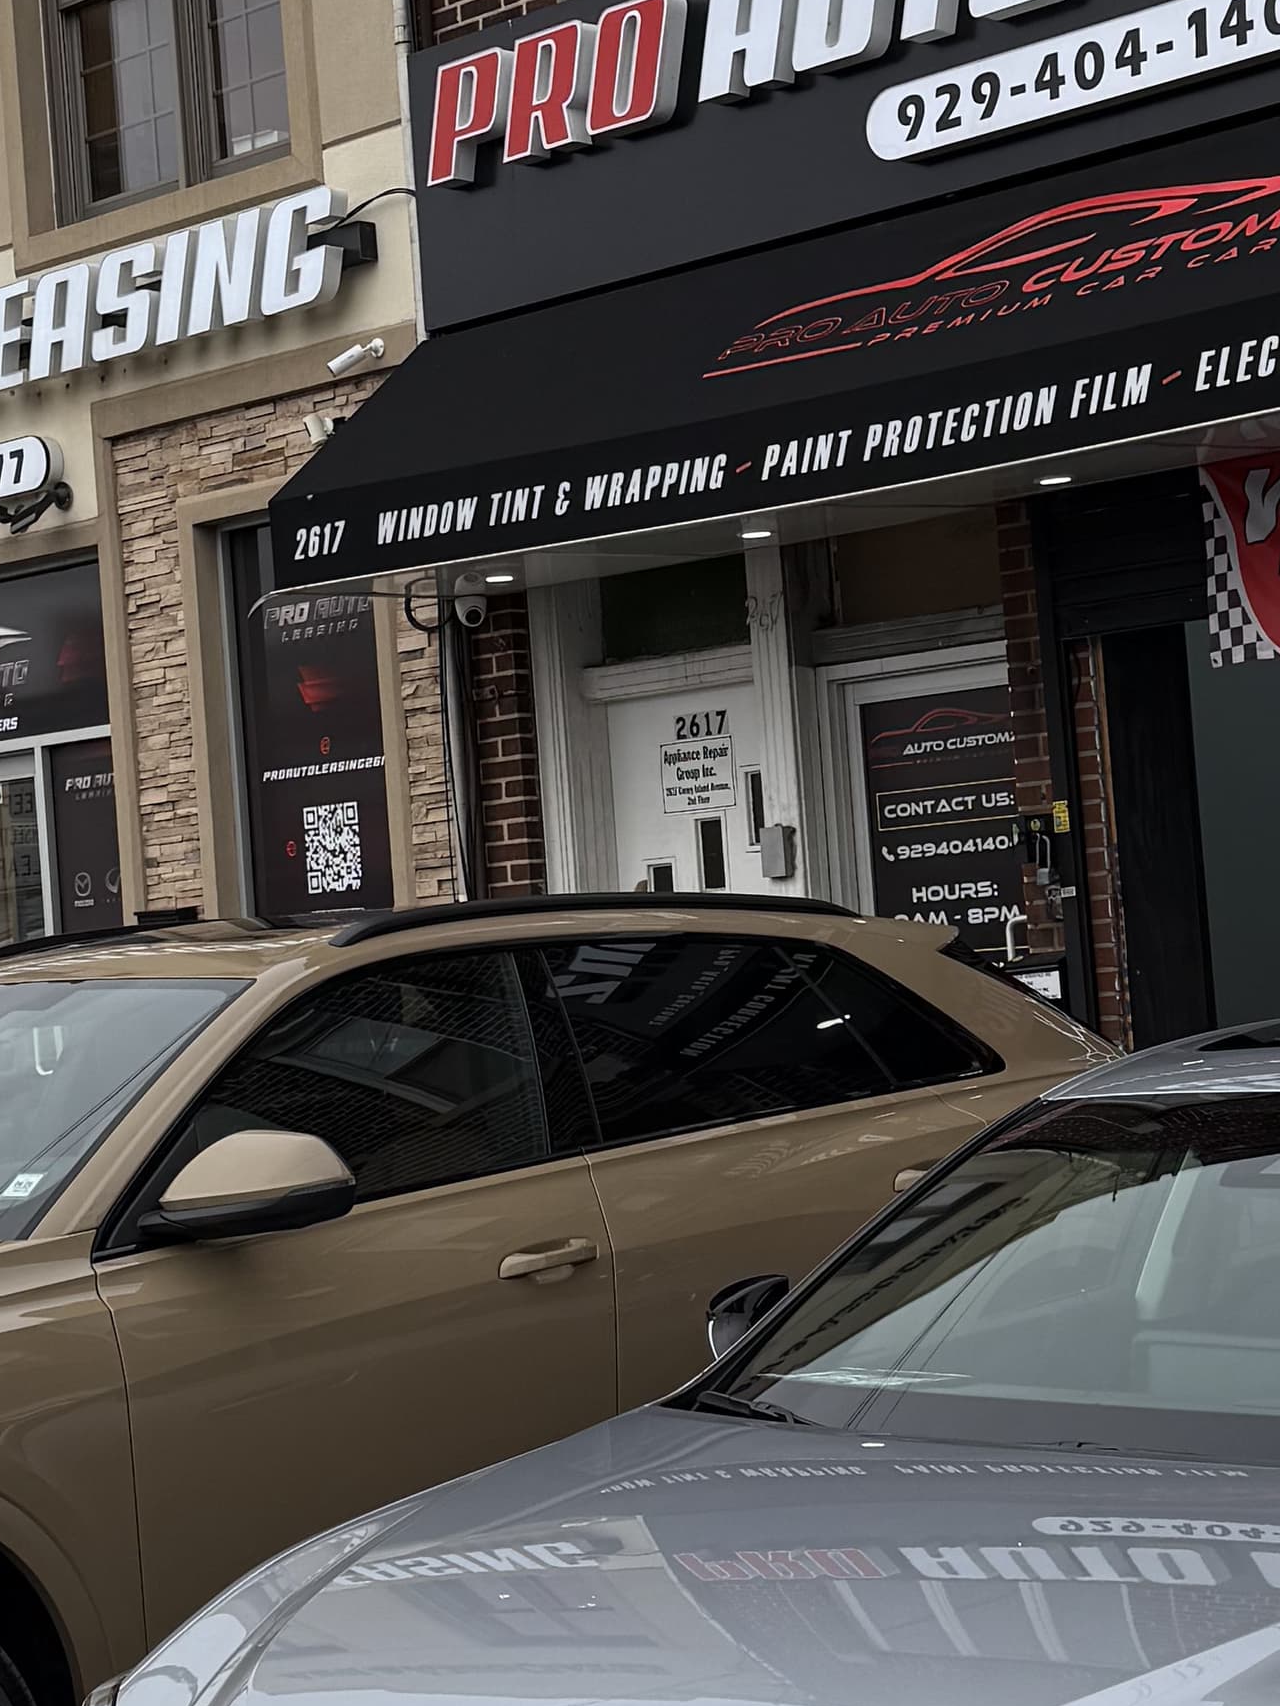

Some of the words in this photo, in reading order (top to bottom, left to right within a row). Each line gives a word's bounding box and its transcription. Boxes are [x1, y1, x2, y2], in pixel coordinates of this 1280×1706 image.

[718, 316, 842, 361] PRO
[842, 279, 1011, 335] AUTO
[868, 294, 1053, 348] PREMIUM
[1076, 266, 1162, 297] CAR
[293, 519, 347, 561] 2617
[377, 496, 478, 546] WINDOW
[488, 484, 546, 527] TINT
[554, 482, 573, 517] &
[583, 453, 728, 512] WRAPPING
[761, 428, 851, 482] PAINT
[862, 393, 1056, 464] PROTECTION
[1069, 363, 1152, 418] FILM
[264, 601, 310, 629] PRO
[675, 709, 726, 740] 2617
[902, 740, 945, 756] AUTO
[884, 795, 976, 819] CONTACT
[981, 792, 1015, 809] US:
[911, 881, 999, 904] HOURS:
[967, 905, 1020, 925] 8PM
